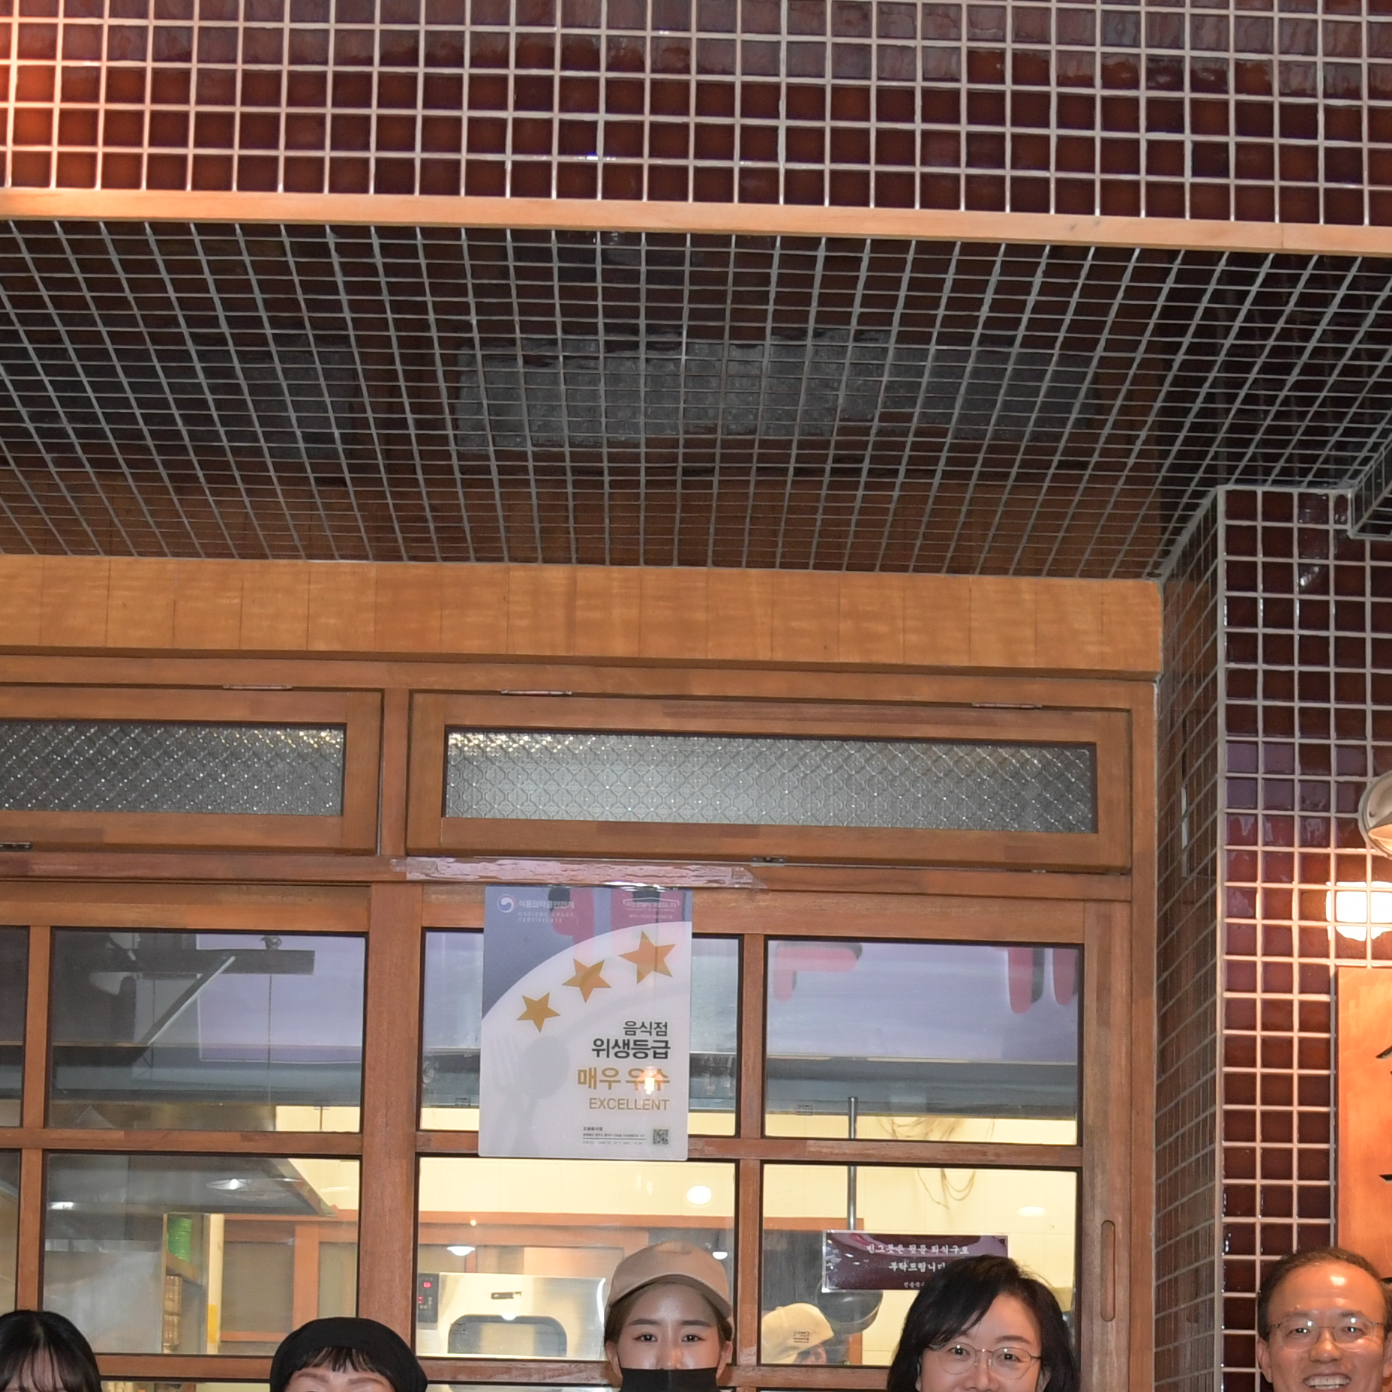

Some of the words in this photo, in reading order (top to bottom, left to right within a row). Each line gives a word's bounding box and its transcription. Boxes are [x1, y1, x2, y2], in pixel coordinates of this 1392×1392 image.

[623, 1020, 669, 1037] 음식점
[591, 1038, 671, 1060] 위생등급
[577, 1067, 622, 1091] 매우
[625, 1067, 671, 1092] 우수
[589, 1097, 670, 1111] EXCELLENT
